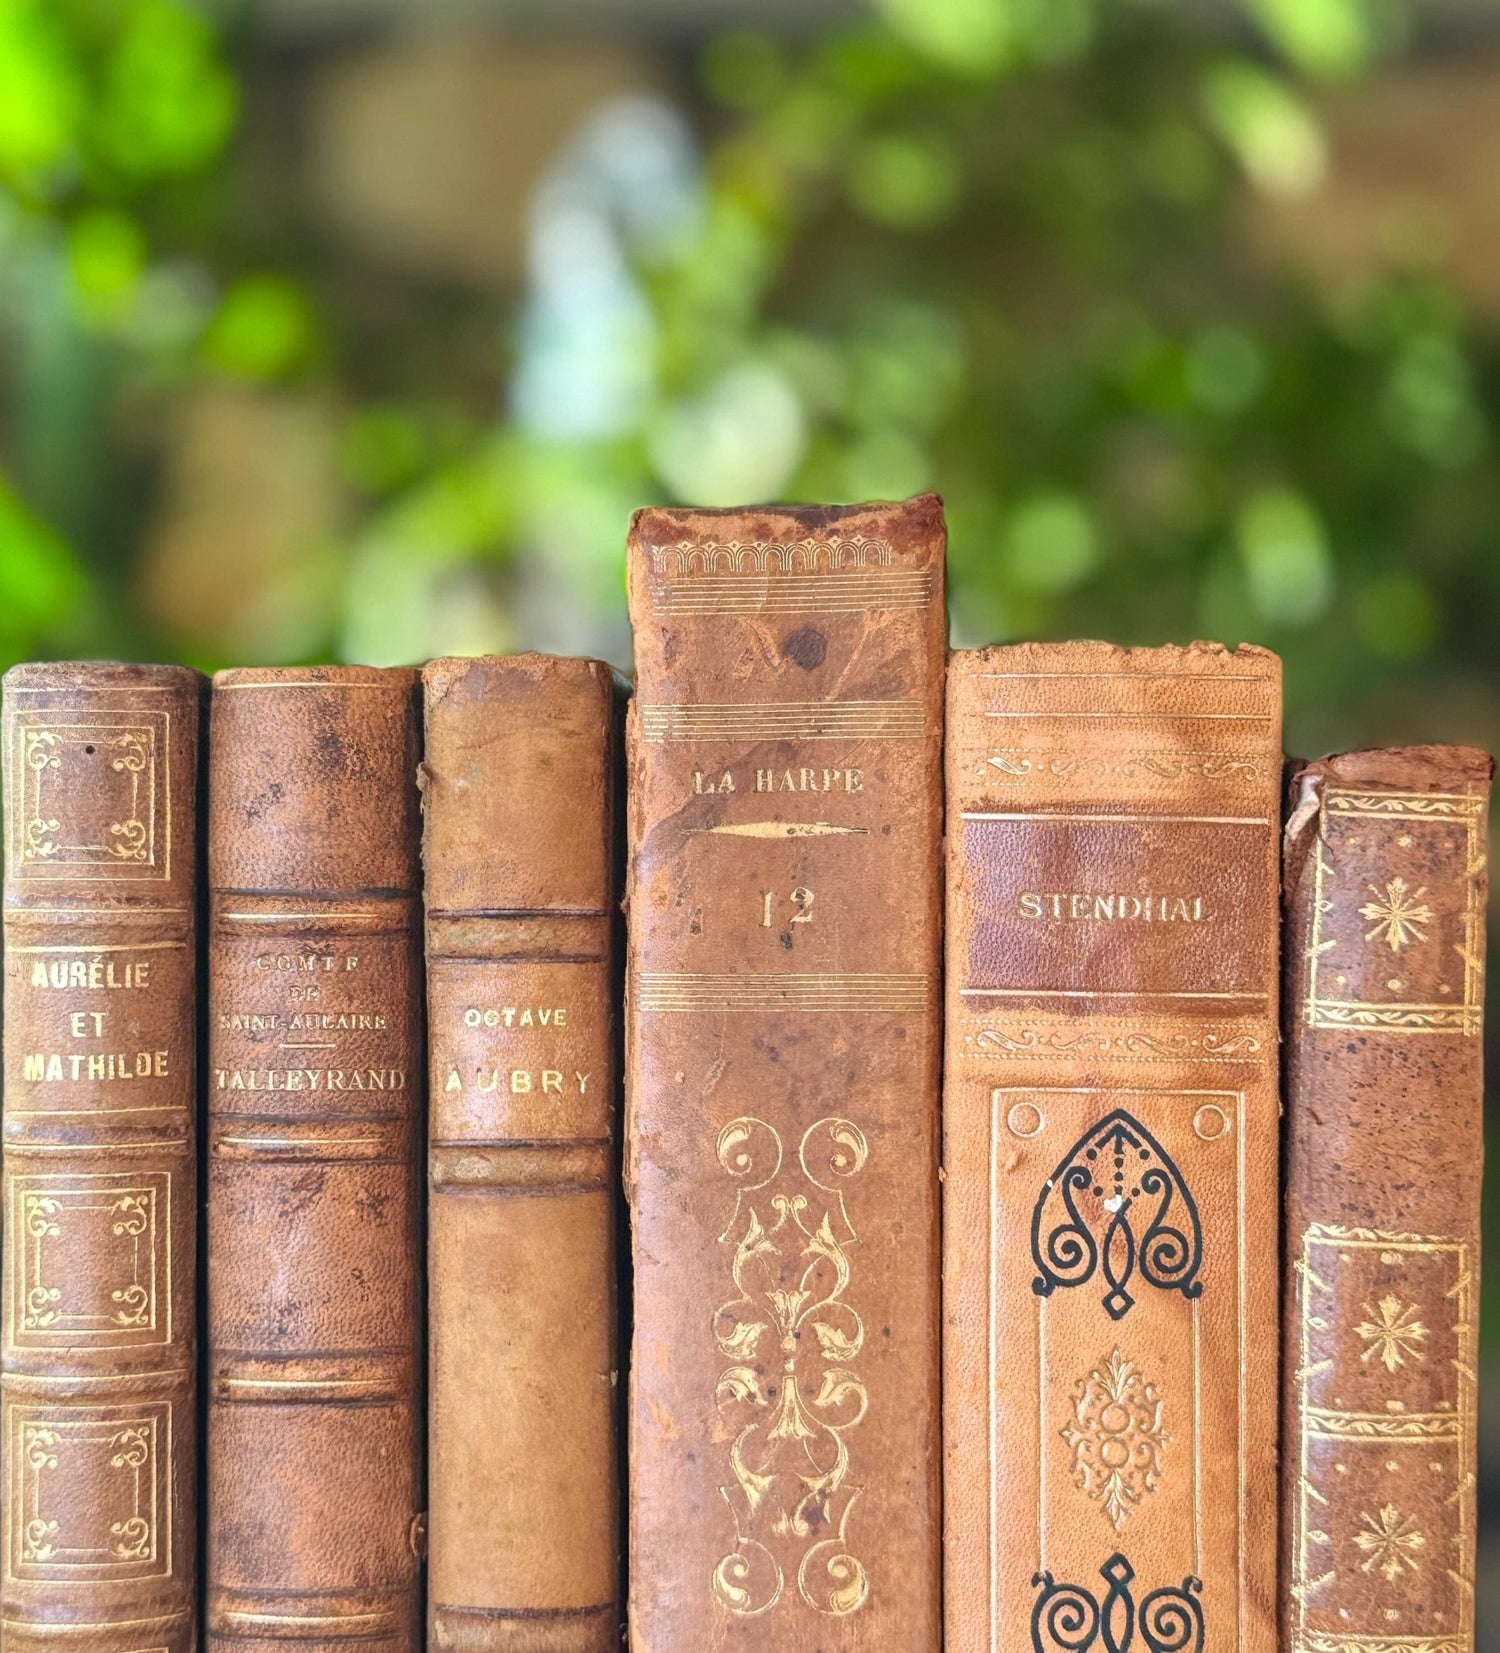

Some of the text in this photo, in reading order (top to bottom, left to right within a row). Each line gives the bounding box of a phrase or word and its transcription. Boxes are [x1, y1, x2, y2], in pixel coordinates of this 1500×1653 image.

[693, 767, 863, 794] LA HARPE
[759, 886, 815, 928] 12
[1018, 892, 1218, 922] STENDHAL
[32, 955, 150, 989] AURÉLIE
[289, 985, 320, 1002] DE
[71, 1011, 109, 1038] ET
[219, 1013, 387, 1031] SAINT-AULAIRE
[464, 1008, 567, 1027] OCTAVE
[24, 1051, 170, 1082] MATHILDE
[215, 1068, 405, 1092] TALLEYRAND
[445, 1068, 593, 1094] AUBRY
